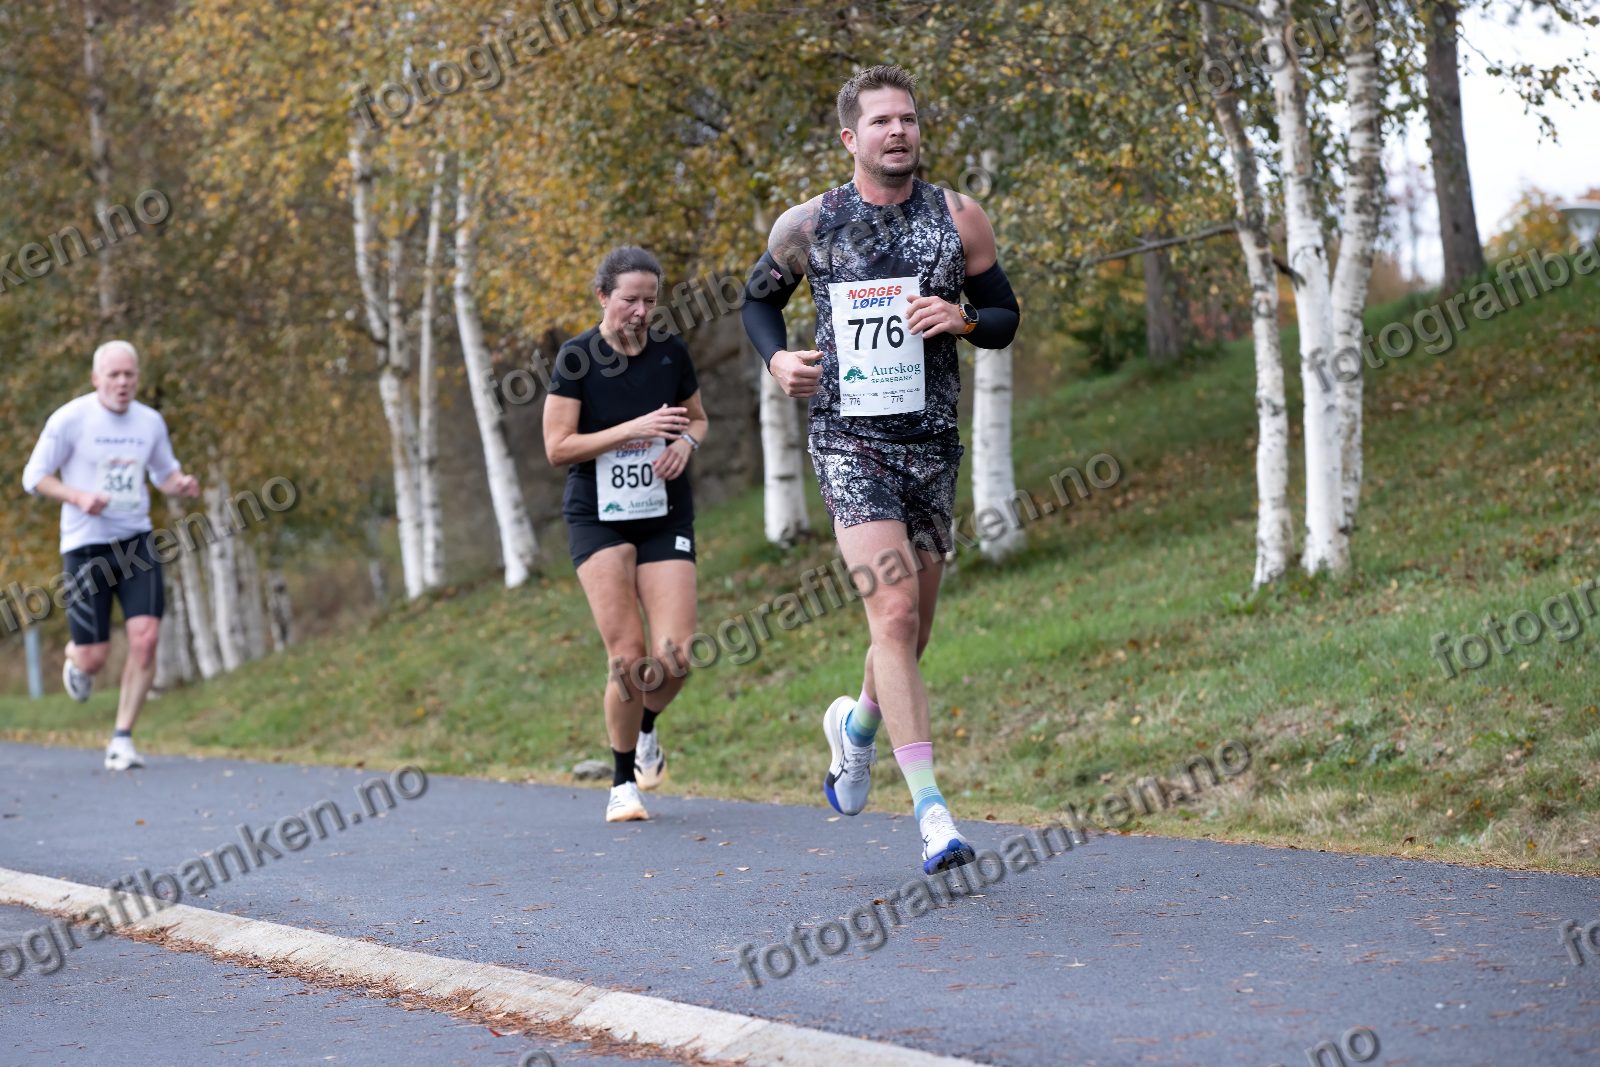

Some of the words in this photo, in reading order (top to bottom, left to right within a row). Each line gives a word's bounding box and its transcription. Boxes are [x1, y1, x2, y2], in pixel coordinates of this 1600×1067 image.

[846, 285, 902, 300] NORGES
[852, 296, 894, 309] LØPET
[847, 315, 904, 350] 776
[871, 363, 921, 376] Aurskog
[611, 463, 653, 489] 850
